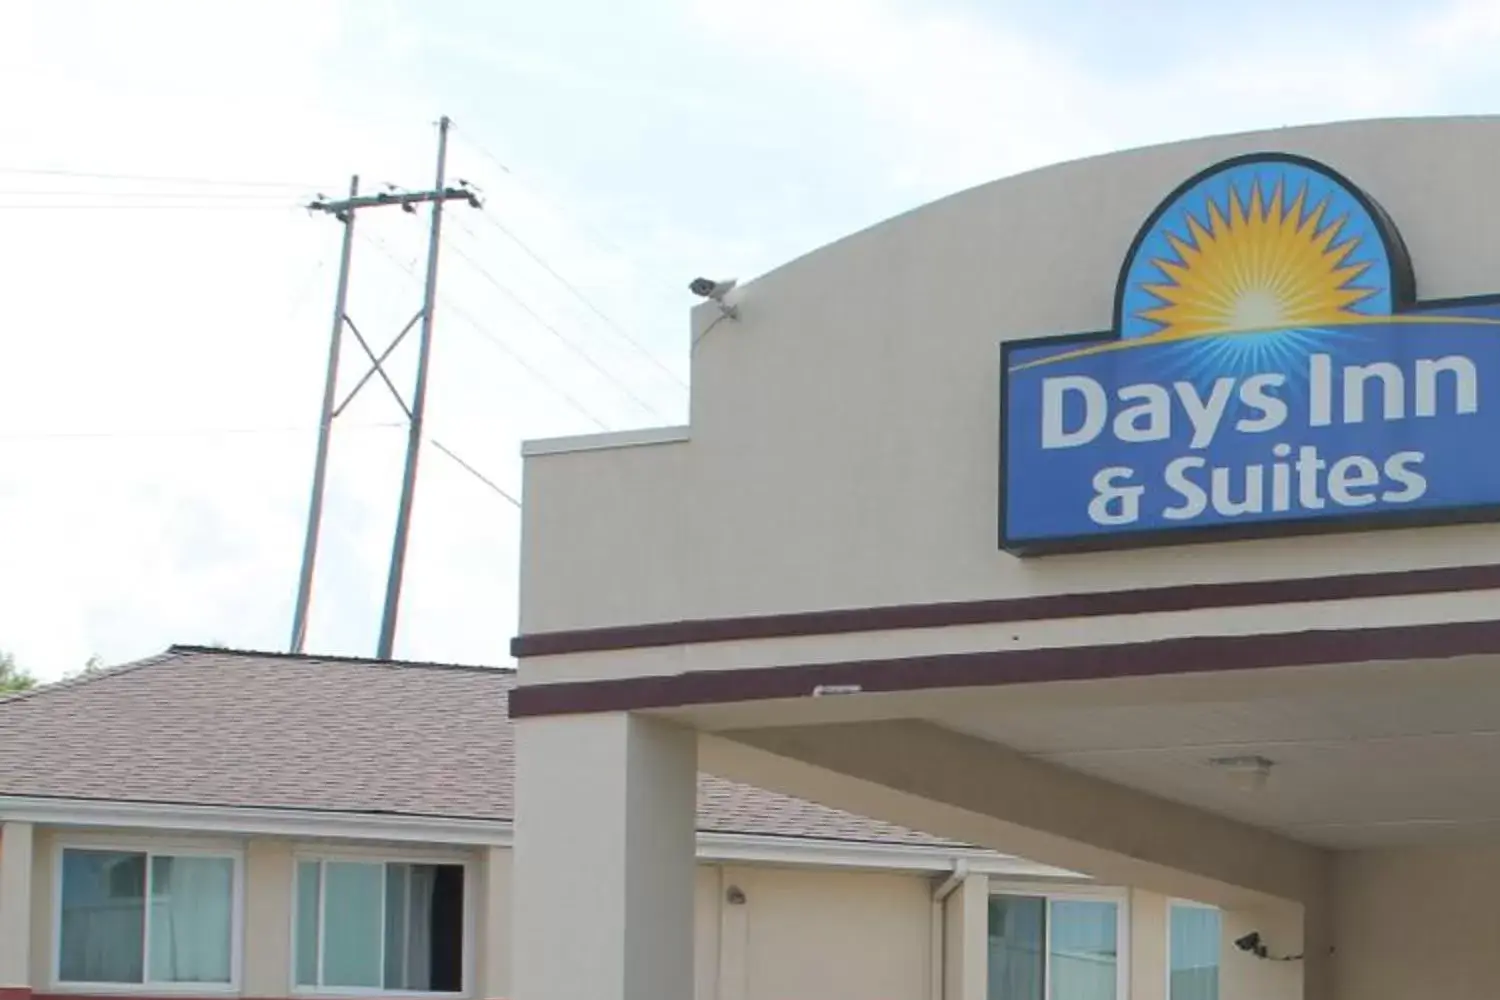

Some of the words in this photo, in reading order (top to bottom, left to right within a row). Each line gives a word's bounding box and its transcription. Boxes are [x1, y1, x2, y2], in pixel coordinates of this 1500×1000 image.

[1042, 374, 1287, 448] Days
[1310, 353, 1477, 427] Inn
[1088, 466, 1145, 525] &
[1164, 444, 1427, 520] Suites
